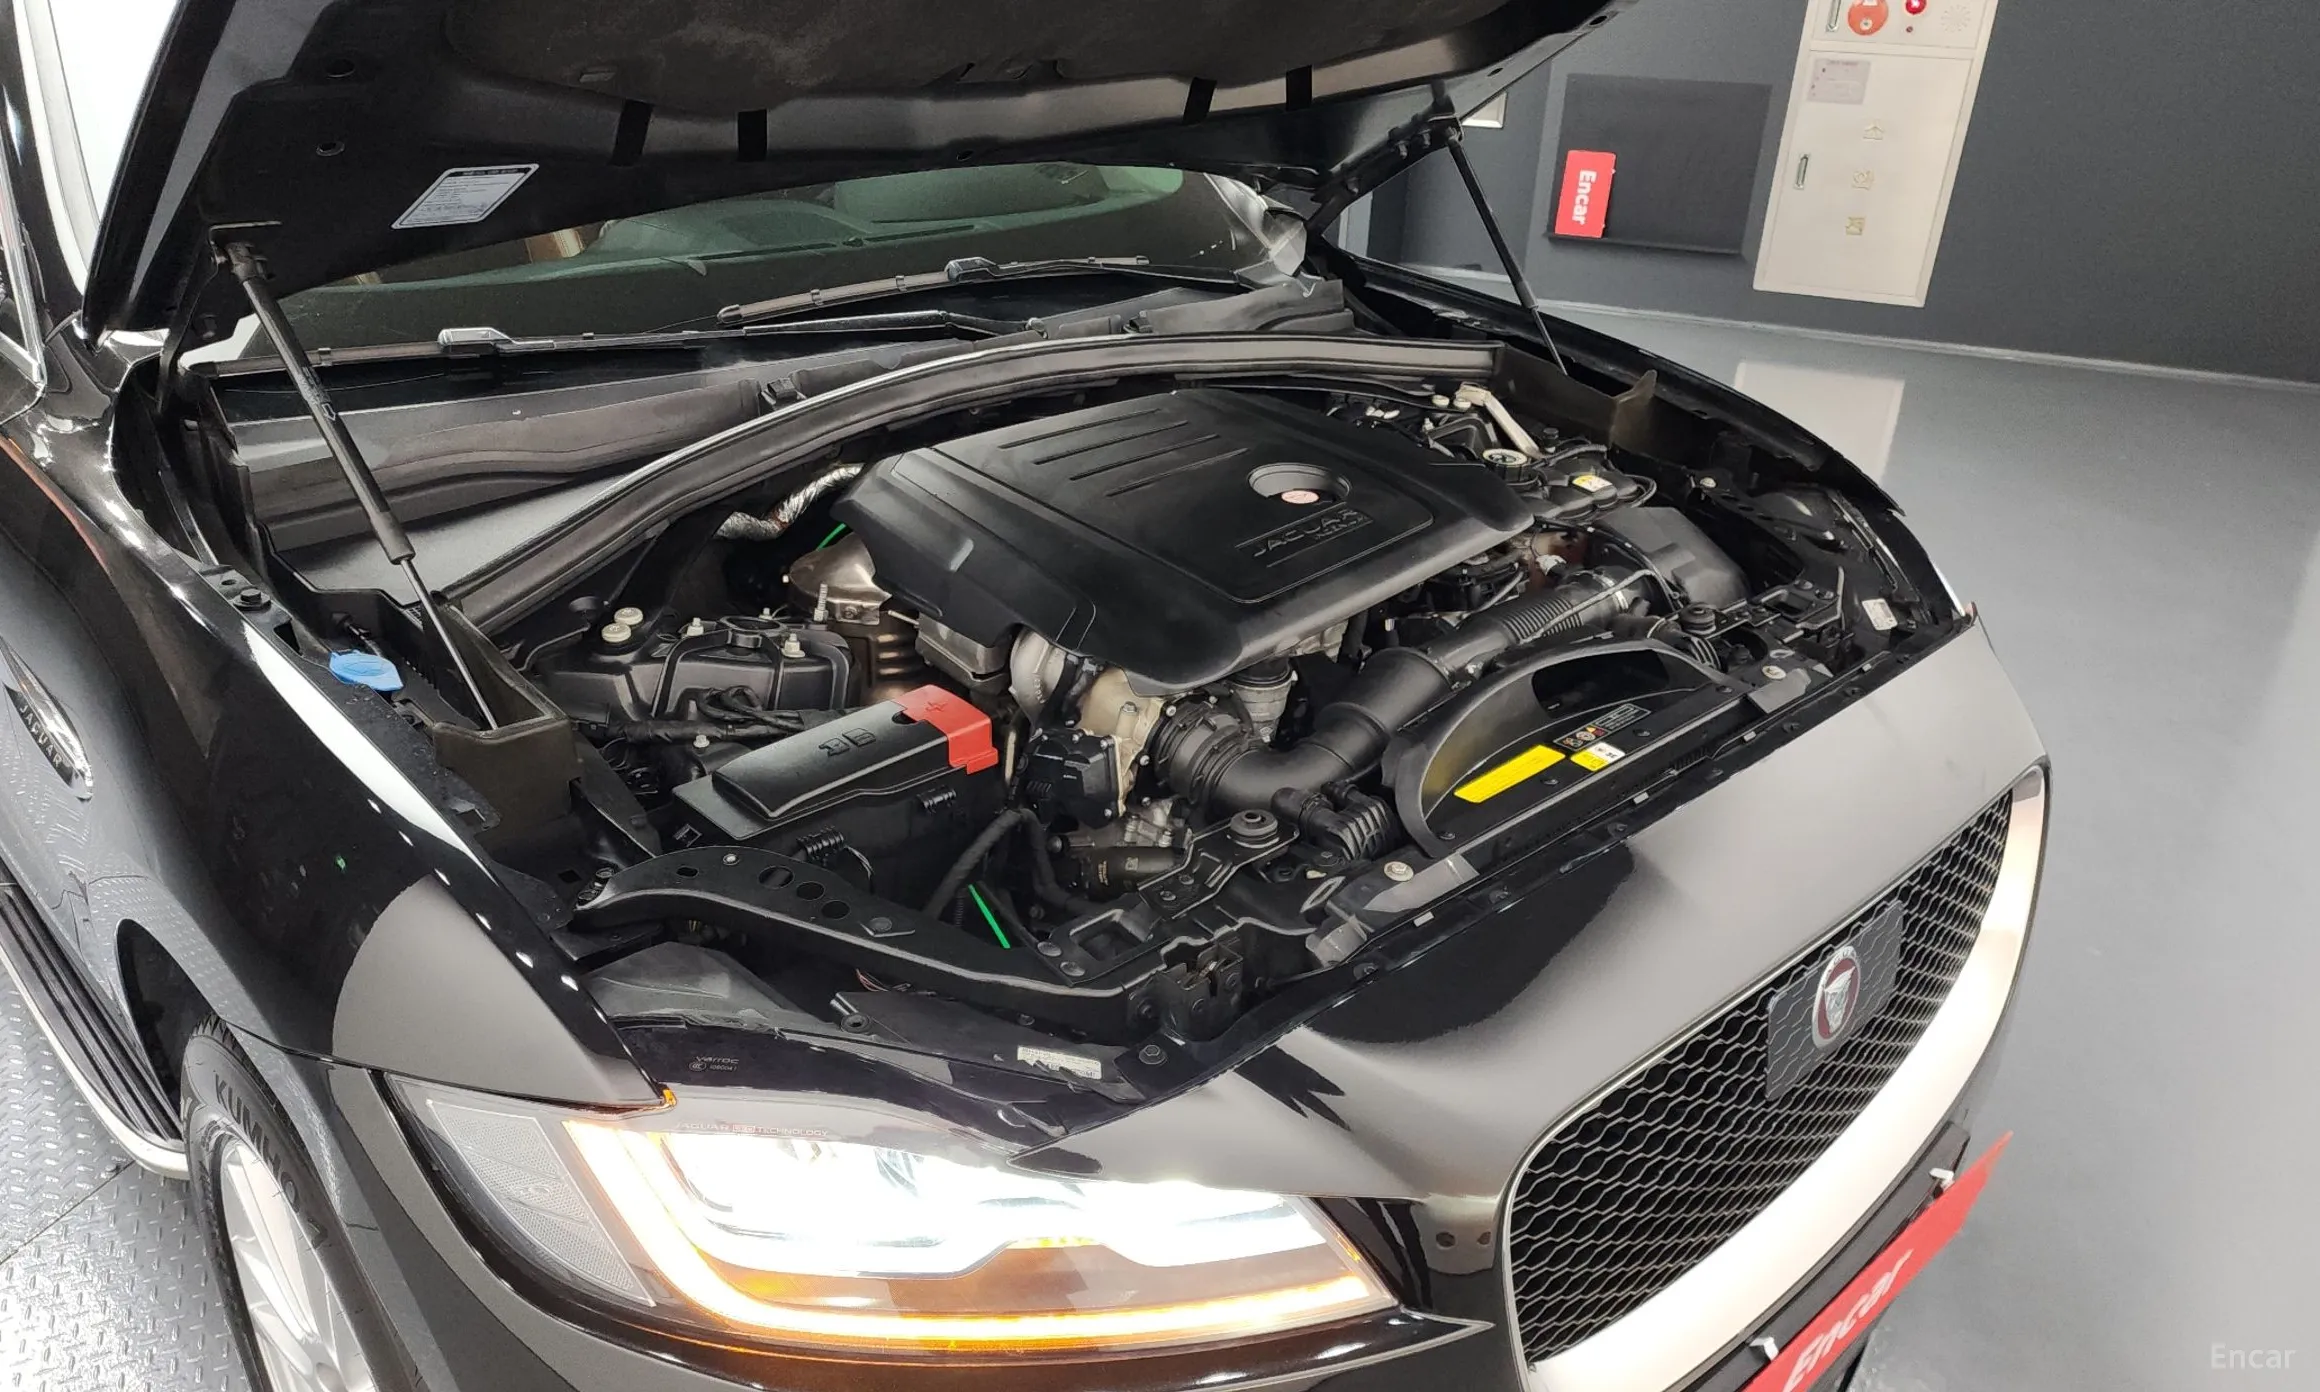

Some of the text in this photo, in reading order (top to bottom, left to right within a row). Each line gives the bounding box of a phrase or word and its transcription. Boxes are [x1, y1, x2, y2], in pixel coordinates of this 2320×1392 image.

[1572, 170, 1597, 225] Encar
[20, 704, 64, 768] JAGUAR
[215, 1074, 300, 1214] KUMHO
[1782, 1249, 1915, 1391] Encar
